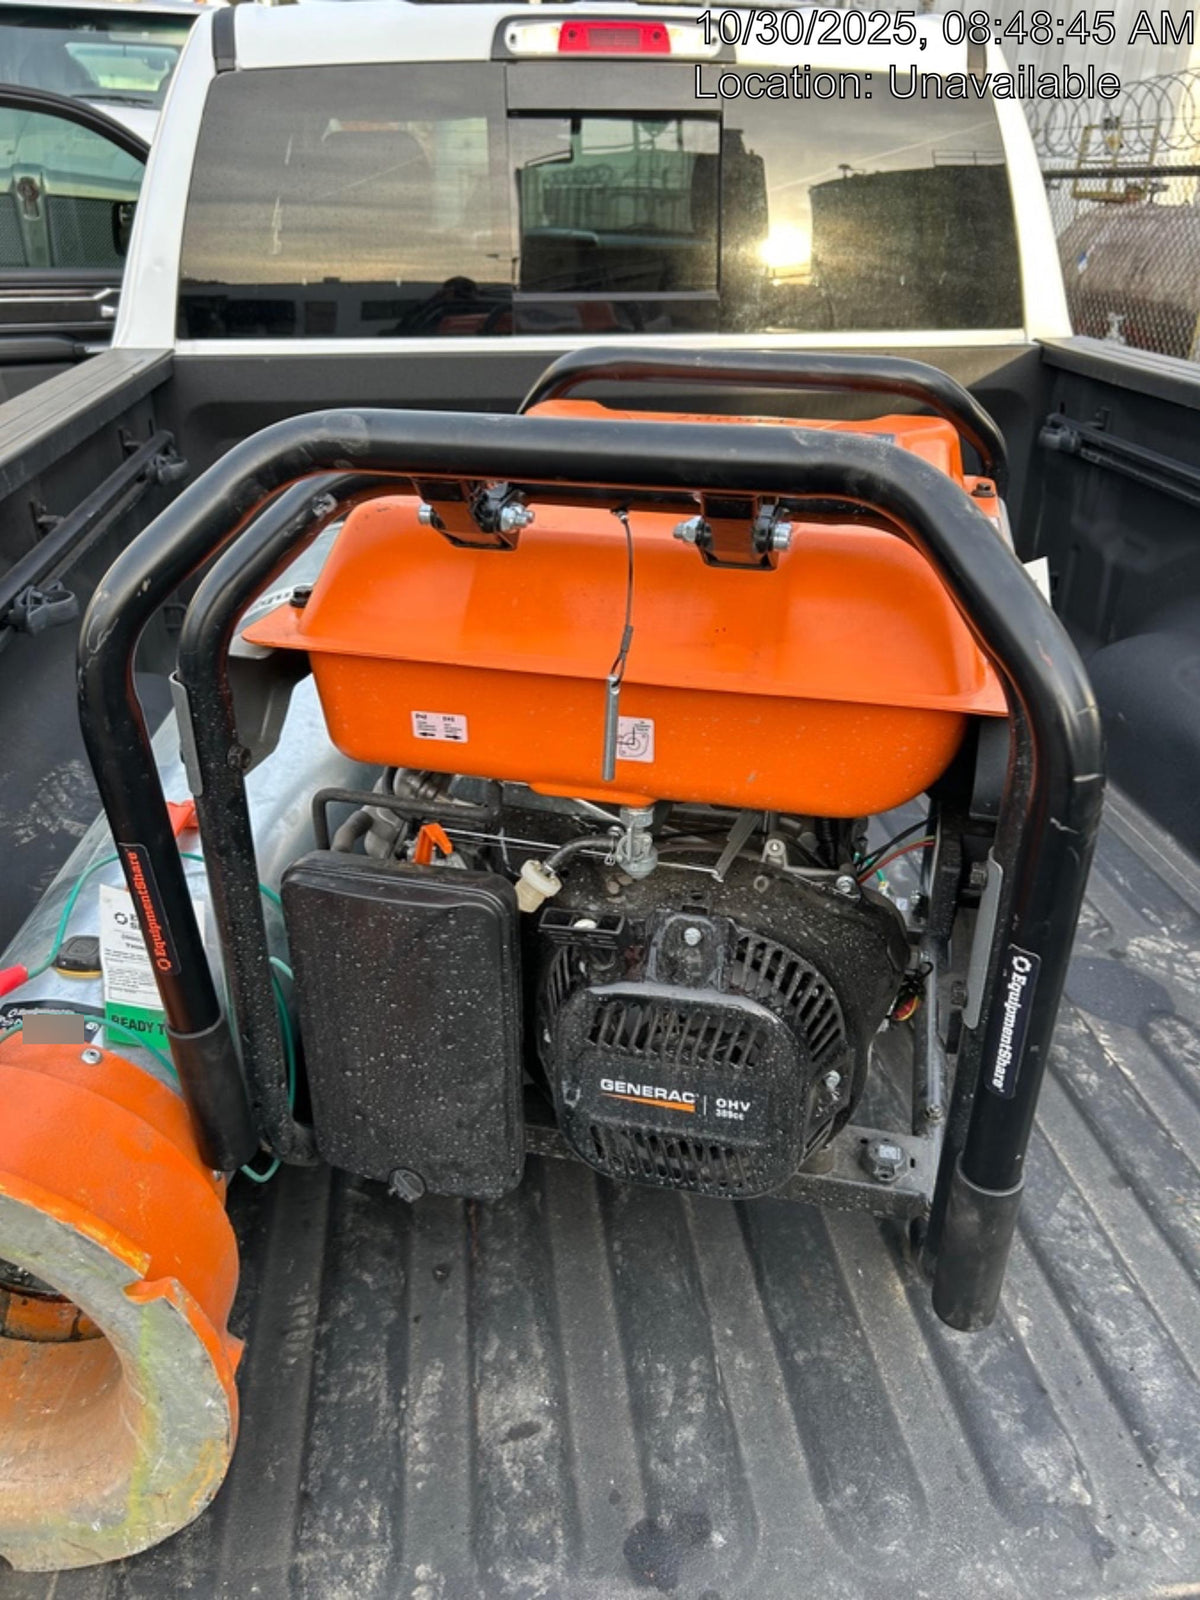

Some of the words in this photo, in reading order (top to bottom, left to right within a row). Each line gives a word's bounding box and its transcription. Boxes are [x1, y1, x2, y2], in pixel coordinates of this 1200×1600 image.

[127, 851, 168, 957] EquipmentShare
[111, 1014, 154, 1033] READY
[992, 972, 1028, 1091] EquipmentShare
[600, 1078, 696, 1104] GENERAC
[716, 1098, 751, 1111] OHV
